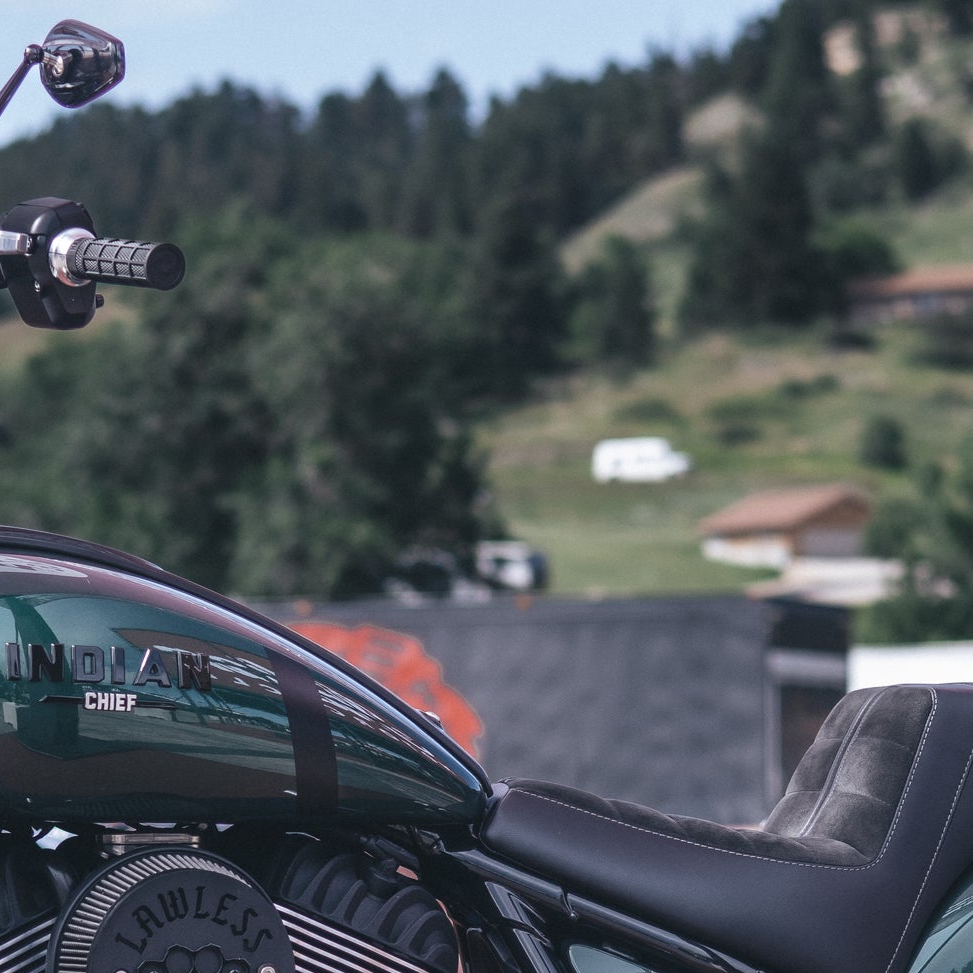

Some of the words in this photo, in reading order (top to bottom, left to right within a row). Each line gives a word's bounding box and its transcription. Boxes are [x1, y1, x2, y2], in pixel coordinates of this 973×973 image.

[5, 642, 212, 691] INDIAN
[84, 692, 137, 712] CHIEF
[115, 886, 273, 955] LAWLESS
